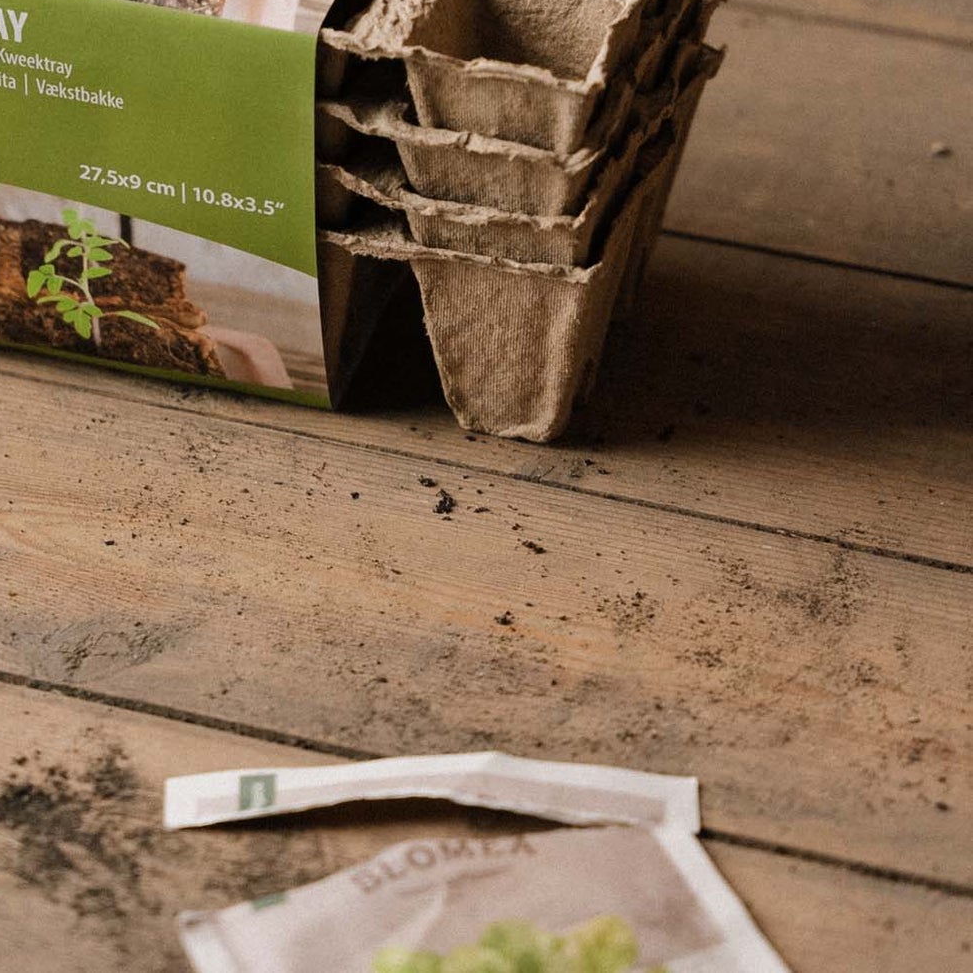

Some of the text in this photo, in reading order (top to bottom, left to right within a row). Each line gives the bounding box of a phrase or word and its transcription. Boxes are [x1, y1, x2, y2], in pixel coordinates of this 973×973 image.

[36, 78, 124, 110] Vækstbakke
[79, 164, 142, 189] 27,5x9
[146, 179, 176, 197] cm
